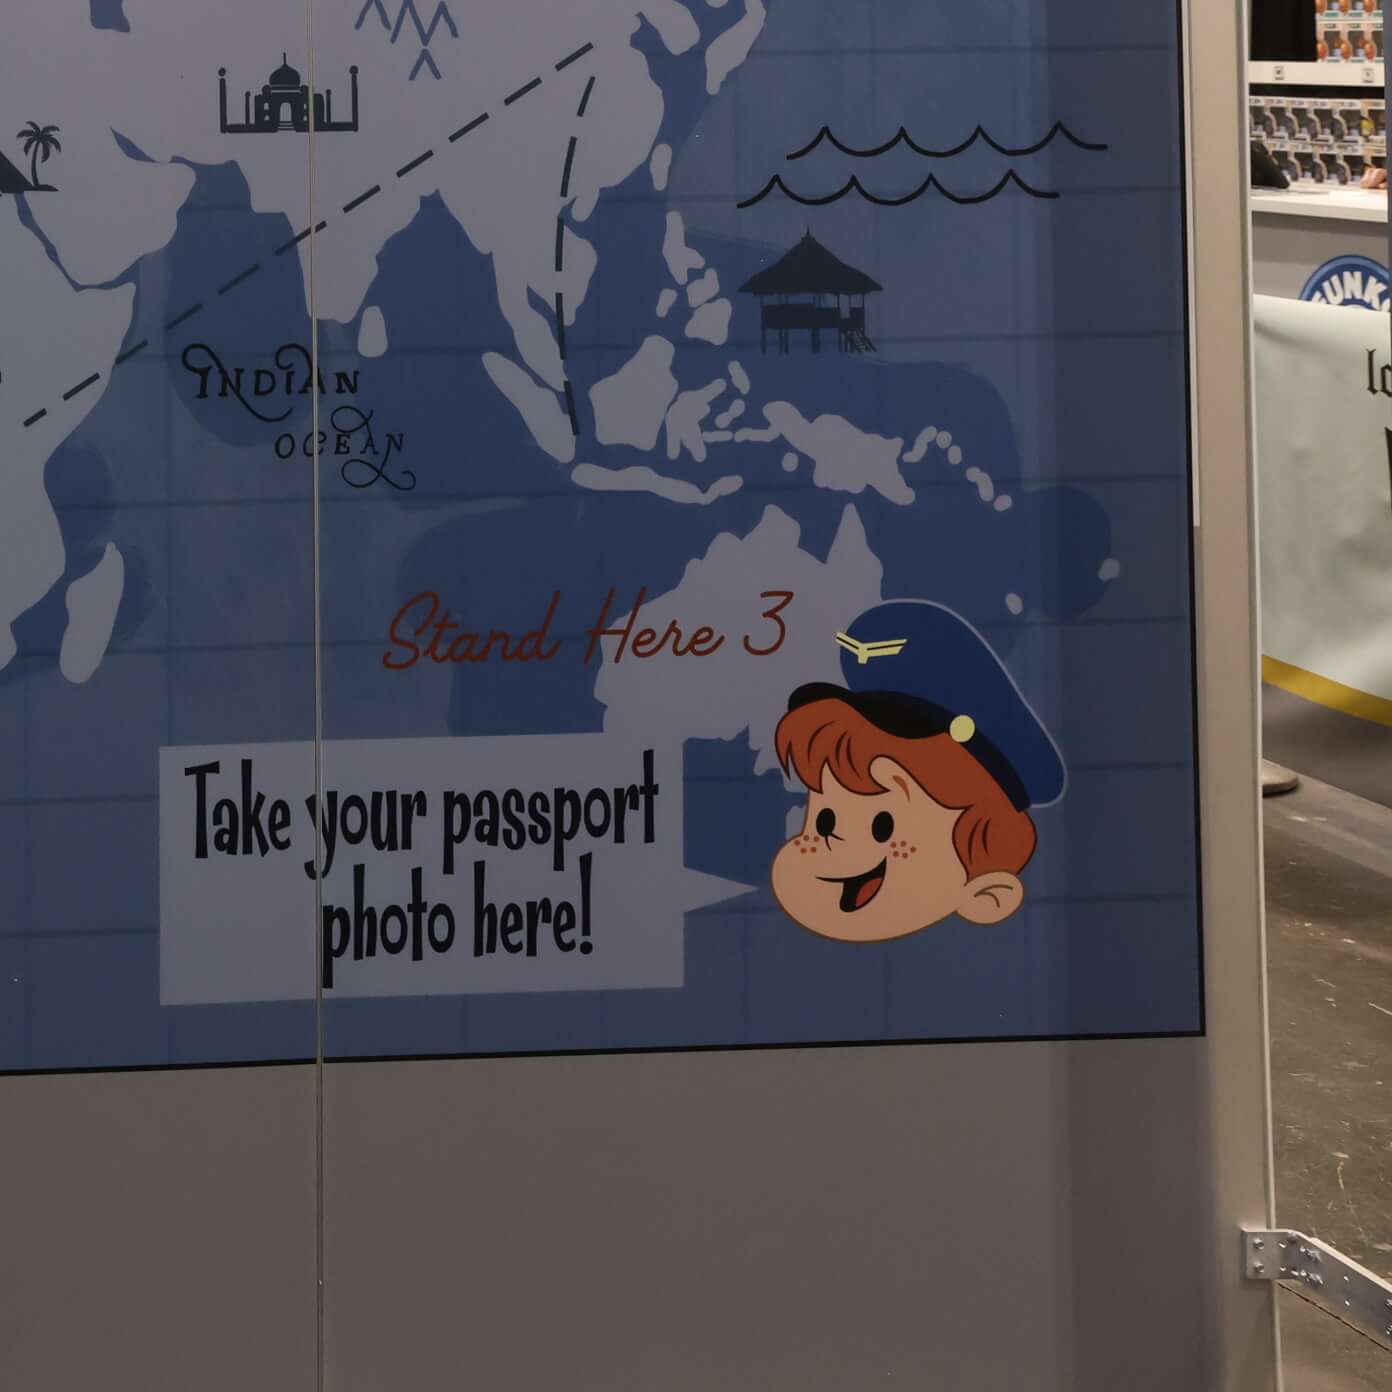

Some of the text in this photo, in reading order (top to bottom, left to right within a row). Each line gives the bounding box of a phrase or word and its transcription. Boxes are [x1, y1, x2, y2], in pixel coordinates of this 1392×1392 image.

[181, 343, 361, 423] INDIAN
[381, 585, 795, 671] Stand Here 3
[183, 747, 660, 881] Take your passport
[320, 851, 594, 990] photo here!
